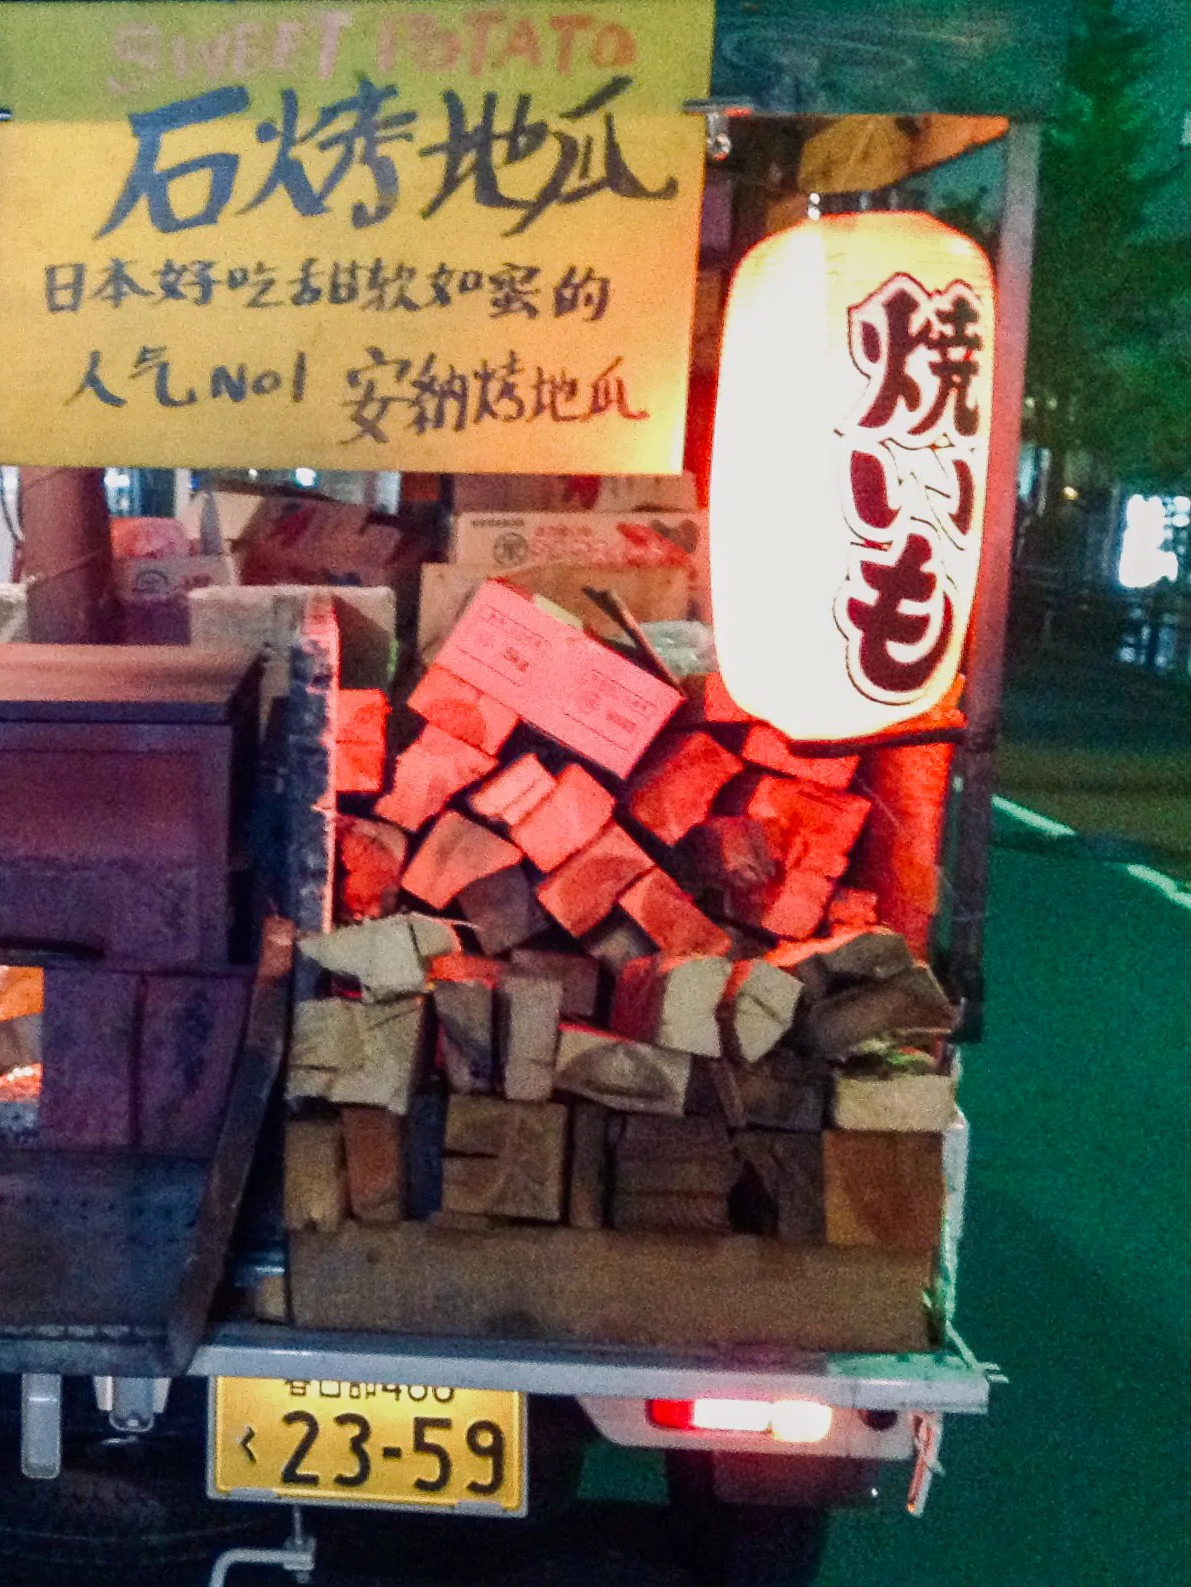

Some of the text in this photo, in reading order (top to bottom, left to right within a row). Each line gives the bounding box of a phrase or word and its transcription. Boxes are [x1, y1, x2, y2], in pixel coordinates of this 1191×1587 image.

[378, 9, 638, 78] POTATO
[94, 72, 677, 239] 石烤地瓜
[845, 275, 985, 702] 焼いも
[280, 1410, 505, 1495] 23-59
